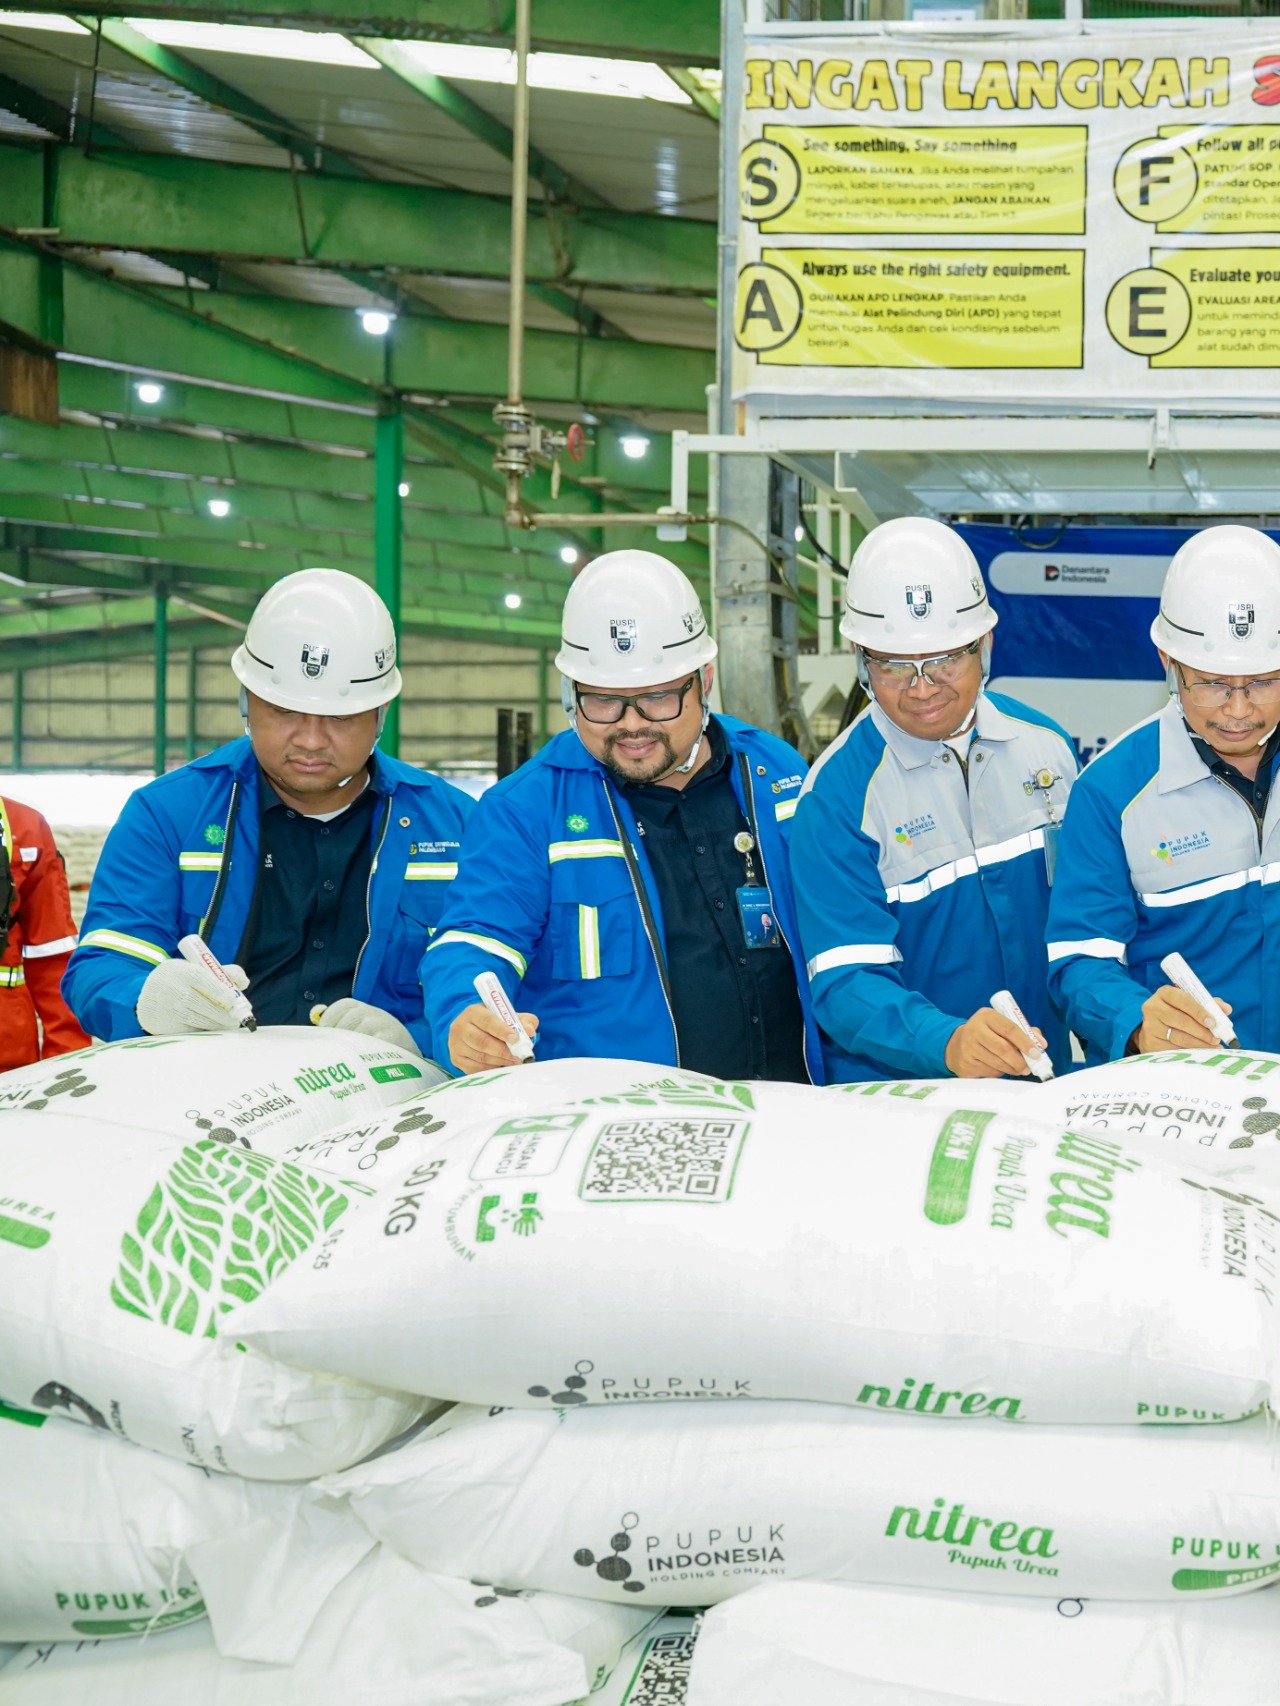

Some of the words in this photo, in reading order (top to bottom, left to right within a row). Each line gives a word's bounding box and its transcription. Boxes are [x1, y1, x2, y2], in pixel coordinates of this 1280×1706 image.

[745, 59, 932, 111] INGAT
[943, 57, 1230, 111] LANGKAH
[803, 138, 829, 151] See
[834, 138, 910, 153] something,
[914, 139, 938, 154] Say
[943, 139, 1017, 153] something
[1248, 137, 1264, 151] all
[745, 157, 778, 206] S
[1139, 156, 1175, 206] F
[802, 262, 848, 277] Always
[853, 264, 877, 276] use
[882, 262, 904, 276] the
[908, 262, 942, 277] right
[946, 263, 988, 277] safety
[993, 263, 1071, 277] equipment.
[1190, 268, 1251, 282] Evaluate
[740, 278, 784, 333] A
[886, 308, 943, 319] Pelindung
[968, 307, 1000, 319] (APD)
[1128, 286, 1168, 338] E
[1061, 565, 1110, 575] Danantara
[1061, 574, 1107, 584] Indonesia
[1228, 603, 1254, 611] SRI
[610, 619, 636, 627] PUSRI
[1167, 830, 1207, 847] PUPUK
[1170, 837, 1210, 853] INDONESIA
[293, 1061, 356, 1095] nitrea
[213, 1081, 284, 1119] PUPUK
[329, 1087, 350, 1102] Pupuk
[347, 1082, 367, 1097] Urea
[230, 1094, 296, 1128] INDONESIA
[1064, 1102, 1226, 1128] INDONESIA
[992, 1134, 1037, 1179] Pupuk
[402, 1158, 448, 1188] 50
[1046, 1129, 1143, 1240] nitrea
[383, 1191, 426, 1237] KG
[990, 1183, 1028, 1230] Urea
[601, 1376, 752, 1392] PUPUK
[857, 1377, 1026, 1422] nitrea
[1136, 1402, 1226, 1421] PUPUK
[645, 1523, 786, 1553] PUPUK
[883, 1497, 1060, 1559] nitrea
[647, 1546, 786, 1572] INDONESIA
[1171, 1536, 1262, 1560] PUPUK
[947, 1548, 1008, 1573] Pupuk
[1012, 1557, 1060, 1578] Urea
[650, 1569, 716, 1584] HOLDING
[55, 1591, 151, 1612] PUPUK
